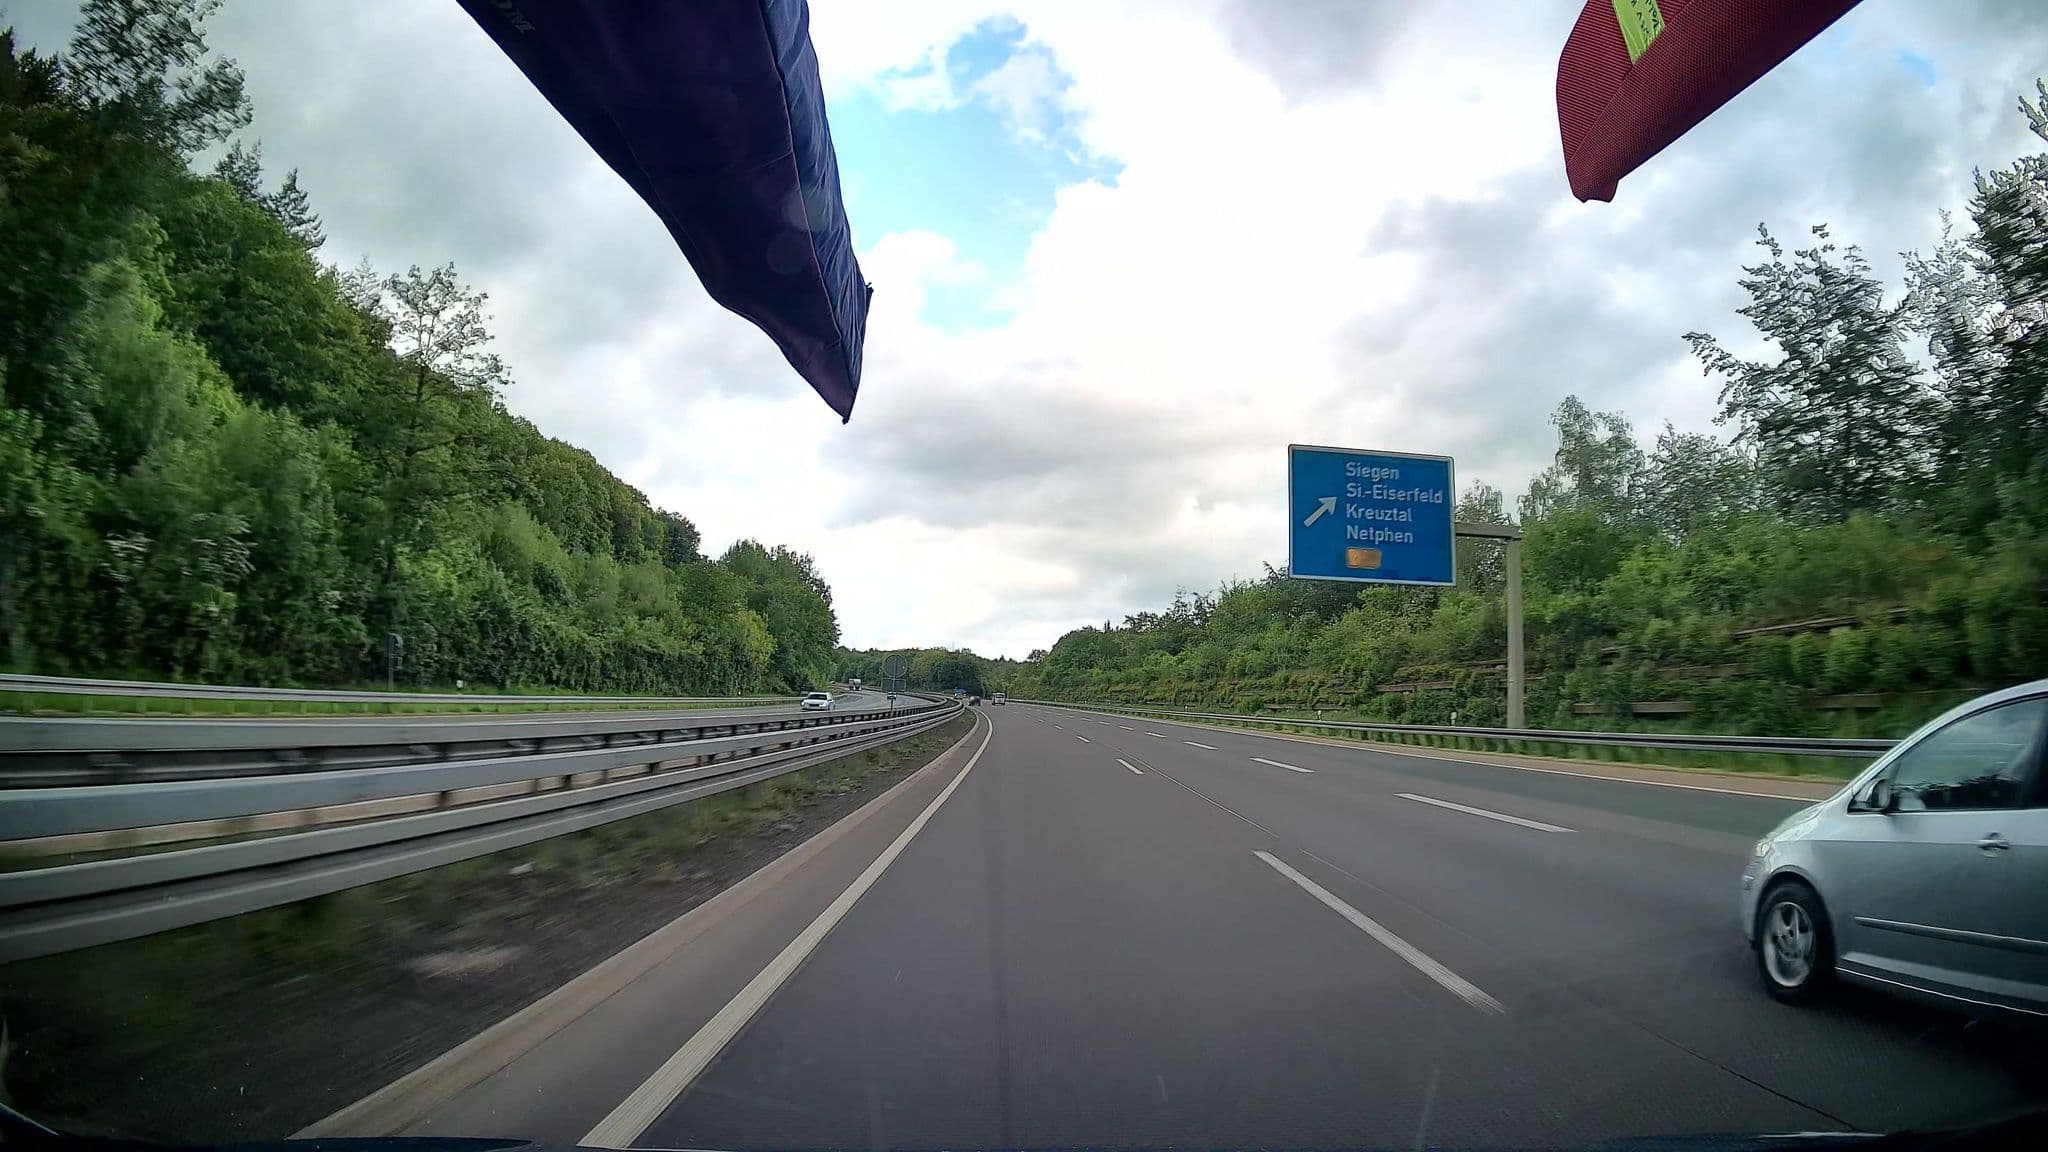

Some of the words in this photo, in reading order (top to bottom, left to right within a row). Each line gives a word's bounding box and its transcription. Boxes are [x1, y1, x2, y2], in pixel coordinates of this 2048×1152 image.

[1346, 461, 1400, 482] Siegen
[1346, 482, 1443, 504] Si.-Eiserfeld
[1346, 503, 1413, 522] Kreuztal
[1346, 524, 1414, 544] Netphen
